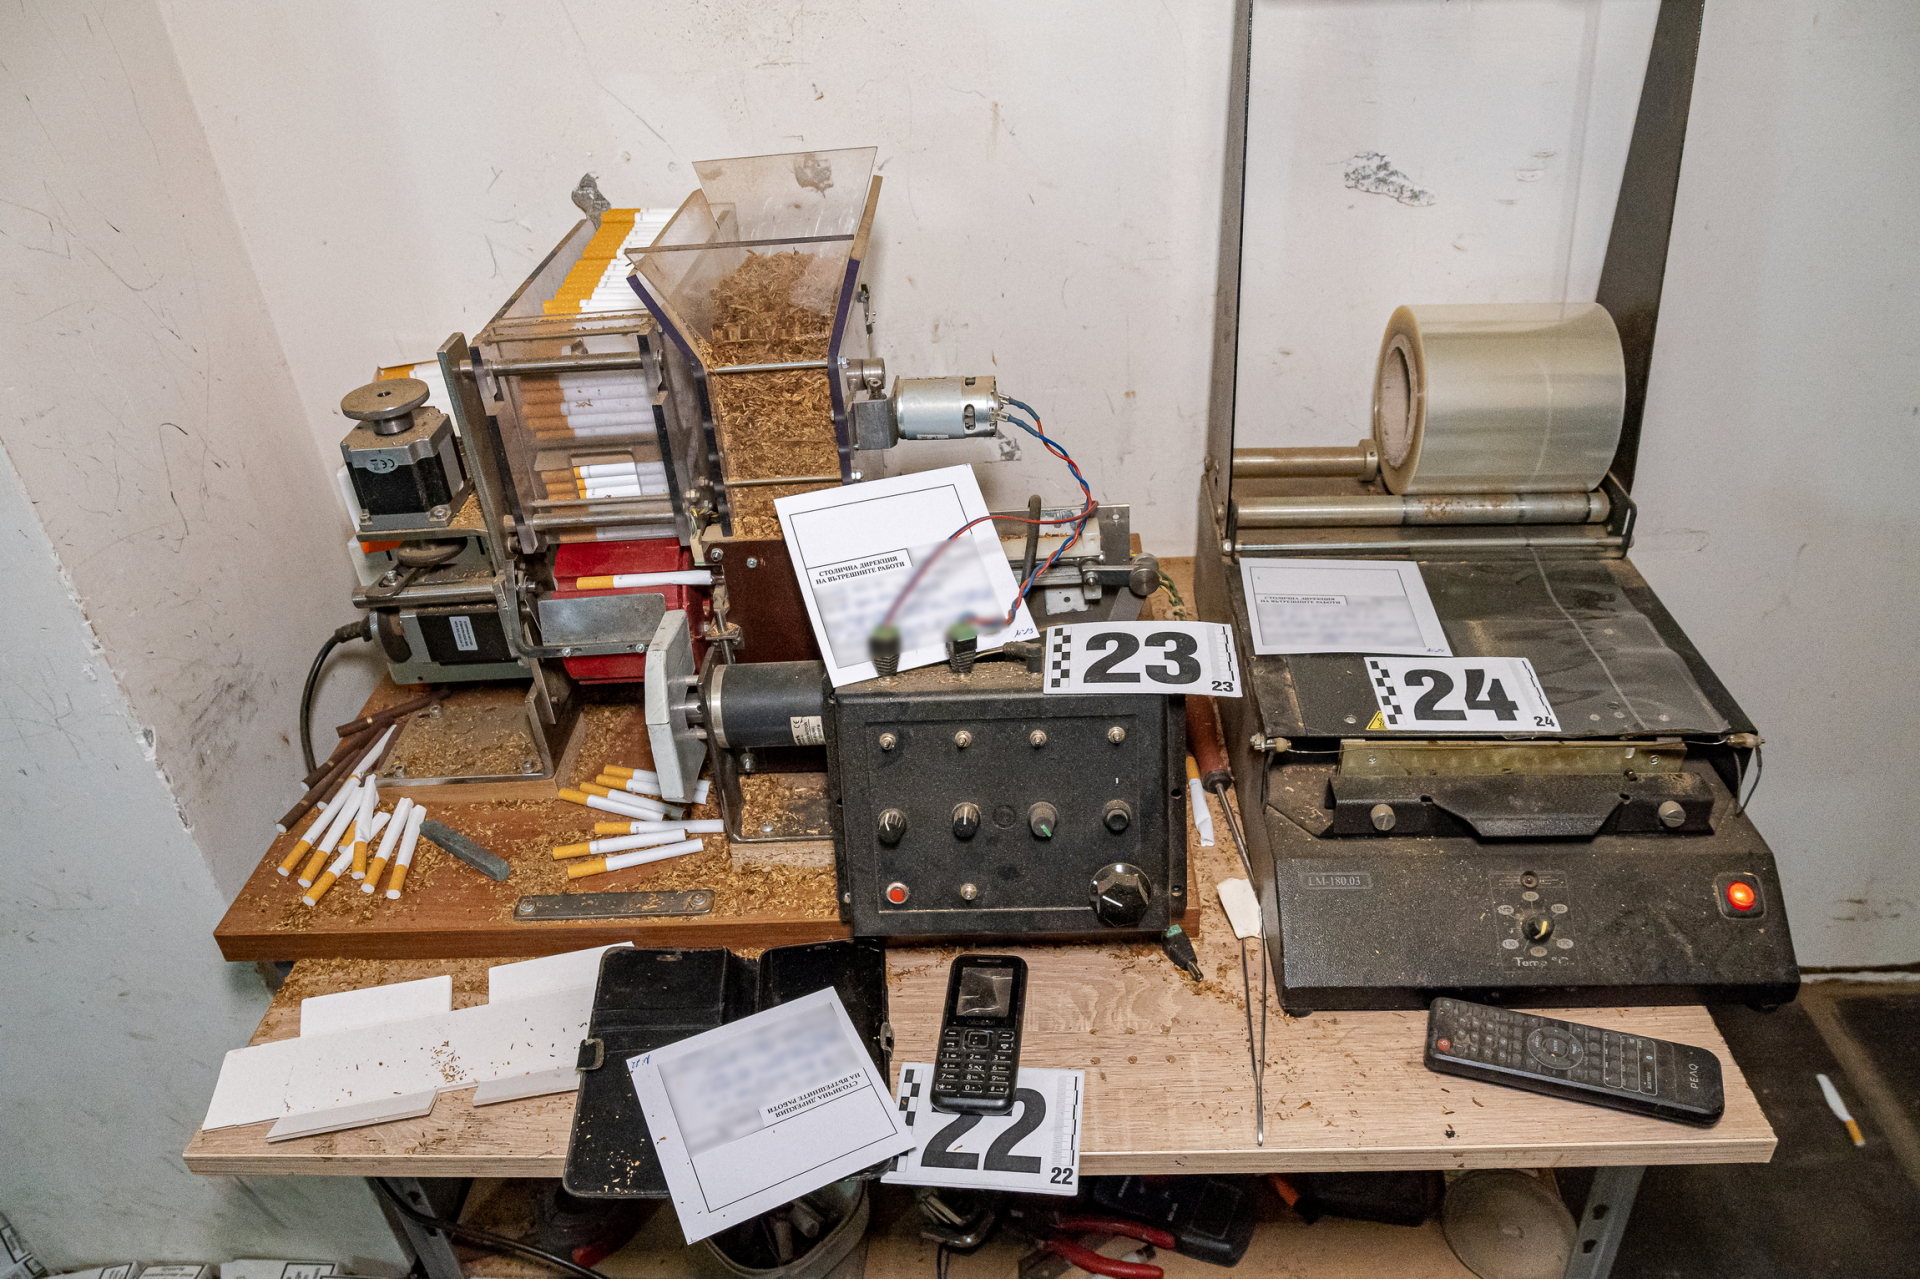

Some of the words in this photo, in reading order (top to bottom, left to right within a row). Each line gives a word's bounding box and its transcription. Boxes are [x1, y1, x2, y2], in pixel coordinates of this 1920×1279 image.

[815, 577, 827, 585] НА
[827, 568, 877, 583] ВЪТРЕШНИТЕ
[878, 561, 905, 572] РАБОТИ
[818, 565, 858, 577] СТОЛИЧНА
[859, 556, 898, 570] ДИРЕКЦИЯ
[1083, 631, 1202, 685] 23
[1211, 680, 1234, 693] 23
[1403, 668, 1520, 721] 24
[1533, 715, 1555, 727] 24
[1308, 876, 1361, 886] LM-180.03
[849, 1072, 861, 1080] НА
[1688, 1063, 1699, 1089] PEAQ
[798, 1076, 849, 1100] ВЪТРЕШНИТЕ
[817, 1080, 859, 1100] СТОЛИЧНА
[767, 1098, 797, 1114] РАБОТИ
[775, 1097, 816, 1118] ДИРЕКЦИЯ
[921, 1087, 1047, 1174] 22
[1050, 1166, 1074, 1185] 22
